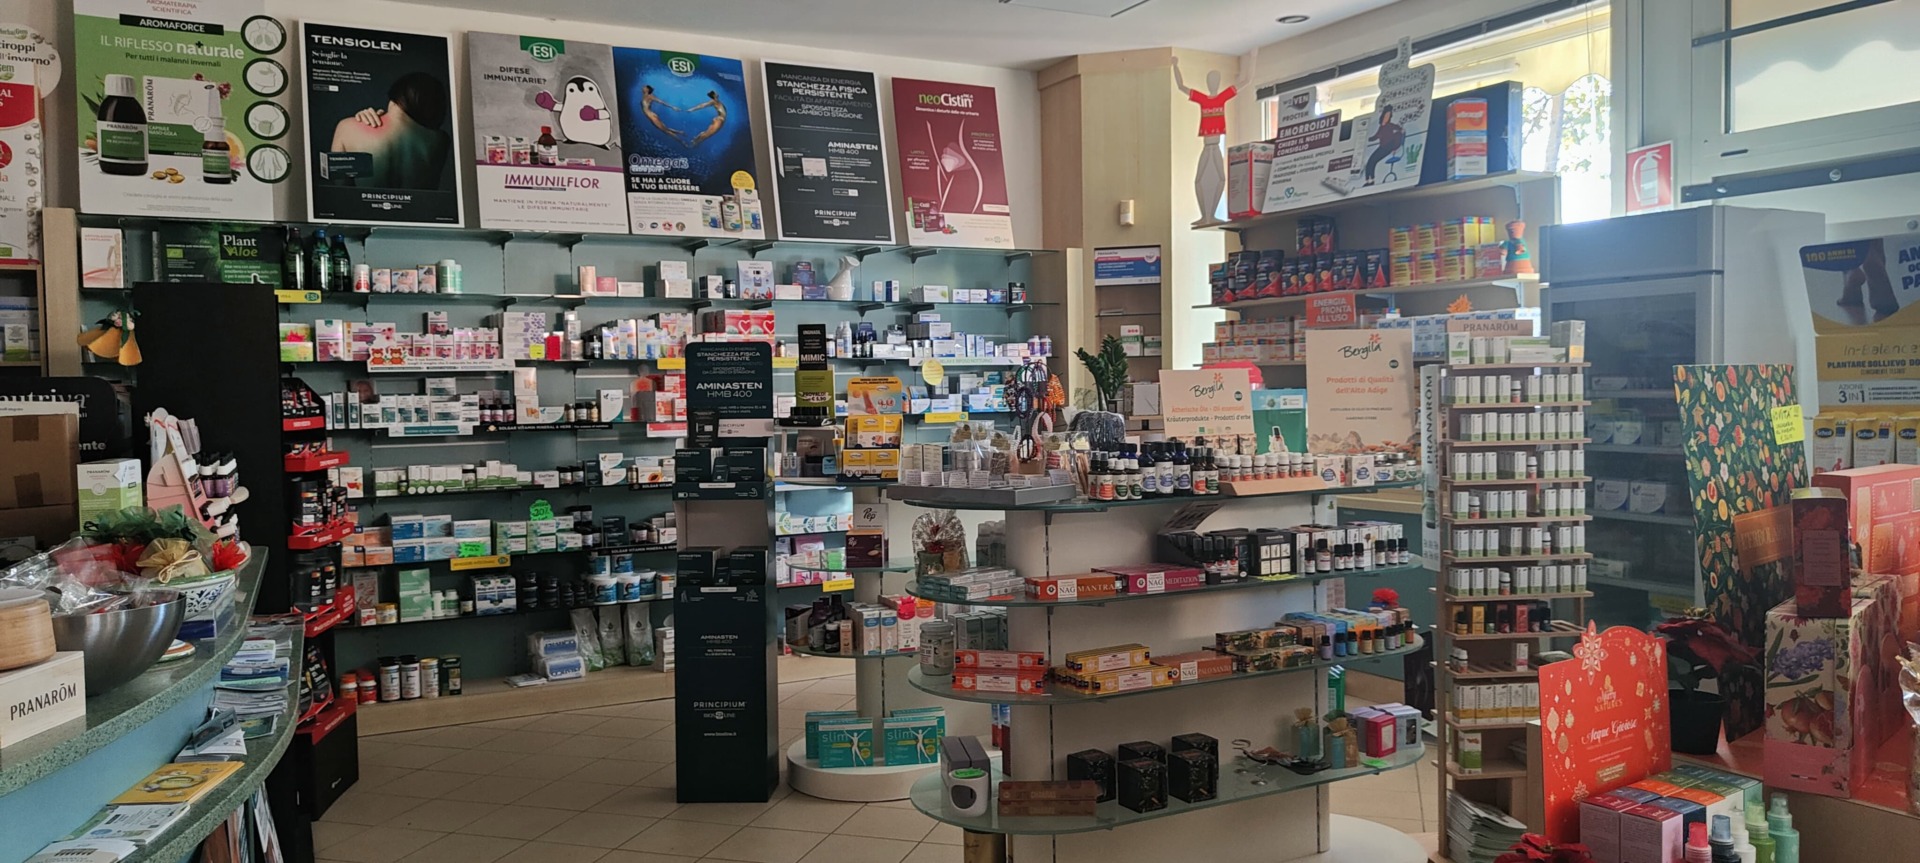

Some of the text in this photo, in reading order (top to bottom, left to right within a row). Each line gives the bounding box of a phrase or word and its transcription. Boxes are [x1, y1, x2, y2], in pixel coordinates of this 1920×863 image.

[152, 6, 193, 15] SCIENTIFICA
[139, 18, 206, 33] AROMAFORCE
[100, 35, 246, 59] IL RIFLESSO naturale
[311, 34, 402, 51] TENSIOLEN
[532, 46, 554, 58] ESI
[138, 54, 155, 62] tutti
[160, 56, 189, 65] malanni
[190, 59, 222, 68] invernali
[672, 60, 692, 73] ESI
[499, 65, 531, 75] DIFESE
[483, 73, 548, 85] IMMUNITARIE?
[781, 73, 822, 82] MANCANZA
[830, 78, 862, 86] ENERGIA
[776, 80, 868, 95] STANCHEZZA FISICA
[792, 88, 854, 100] PERSISTENTE
[918, 93, 973, 108] neoCistin
[801, 104, 849, 113] SPOSSATEZZA
[831, 111, 863, 119] STAGIONE
[1280, 117, 1336, 139] EMORROIDI?
[828, 141, 879, 151] AMINASTEN
[1278, 139, 1299, 149] CHIEDI
[1305, 132, 1331, 143] NOSTRO
[1277, 144, 1309, 156] CONSIGLIO
[504, 174, 600, 189] IMMUNILFLOR
[658, 184, 700, 192] BENESSERE
[361, 193, 411, 201] PRINCIPIUM
[814, 209, 857, 217] PRINCIPIUM
[222, 234, 257, 247] Plant
[229, 246, 259, 257] Aloe
[1806, 252, 1826, 262] 100
[306, 292, 319, 301] ESI
[1313, 297, 1347, 307] ENERGIA
[1321, 305, 1352, 314] PRONTA
[1316, 313, 1348, 323] ALL'USO
[1337, 342, 1383, 360] Bergila
[800, 353, 826, 362] MIMIC
[1827, 361, 1867, 369] PLANTARE
[1367, 375, 1394, 384] Qualità
[696, 382, 763, 390] AMINASTEN
[1189, 382, 1225, 399] Bergila
[1367, 387, 1388, 395] Adige
[706, 390, 753, 398] HMB 400
[1838, 390, 1847, 403] 3
[1848, 392, 1859, 401] IN
[1859, 390, 1865, 403] 1
[1147, 578, 1164, 587] NAG
[1165, 573, 1200, 585] MEDITATION
[1058, 583, 1116, 595] NAG MANTRA
[1182, 669, 1198, 677] NAG
[822, 730, 849, 743] slim
